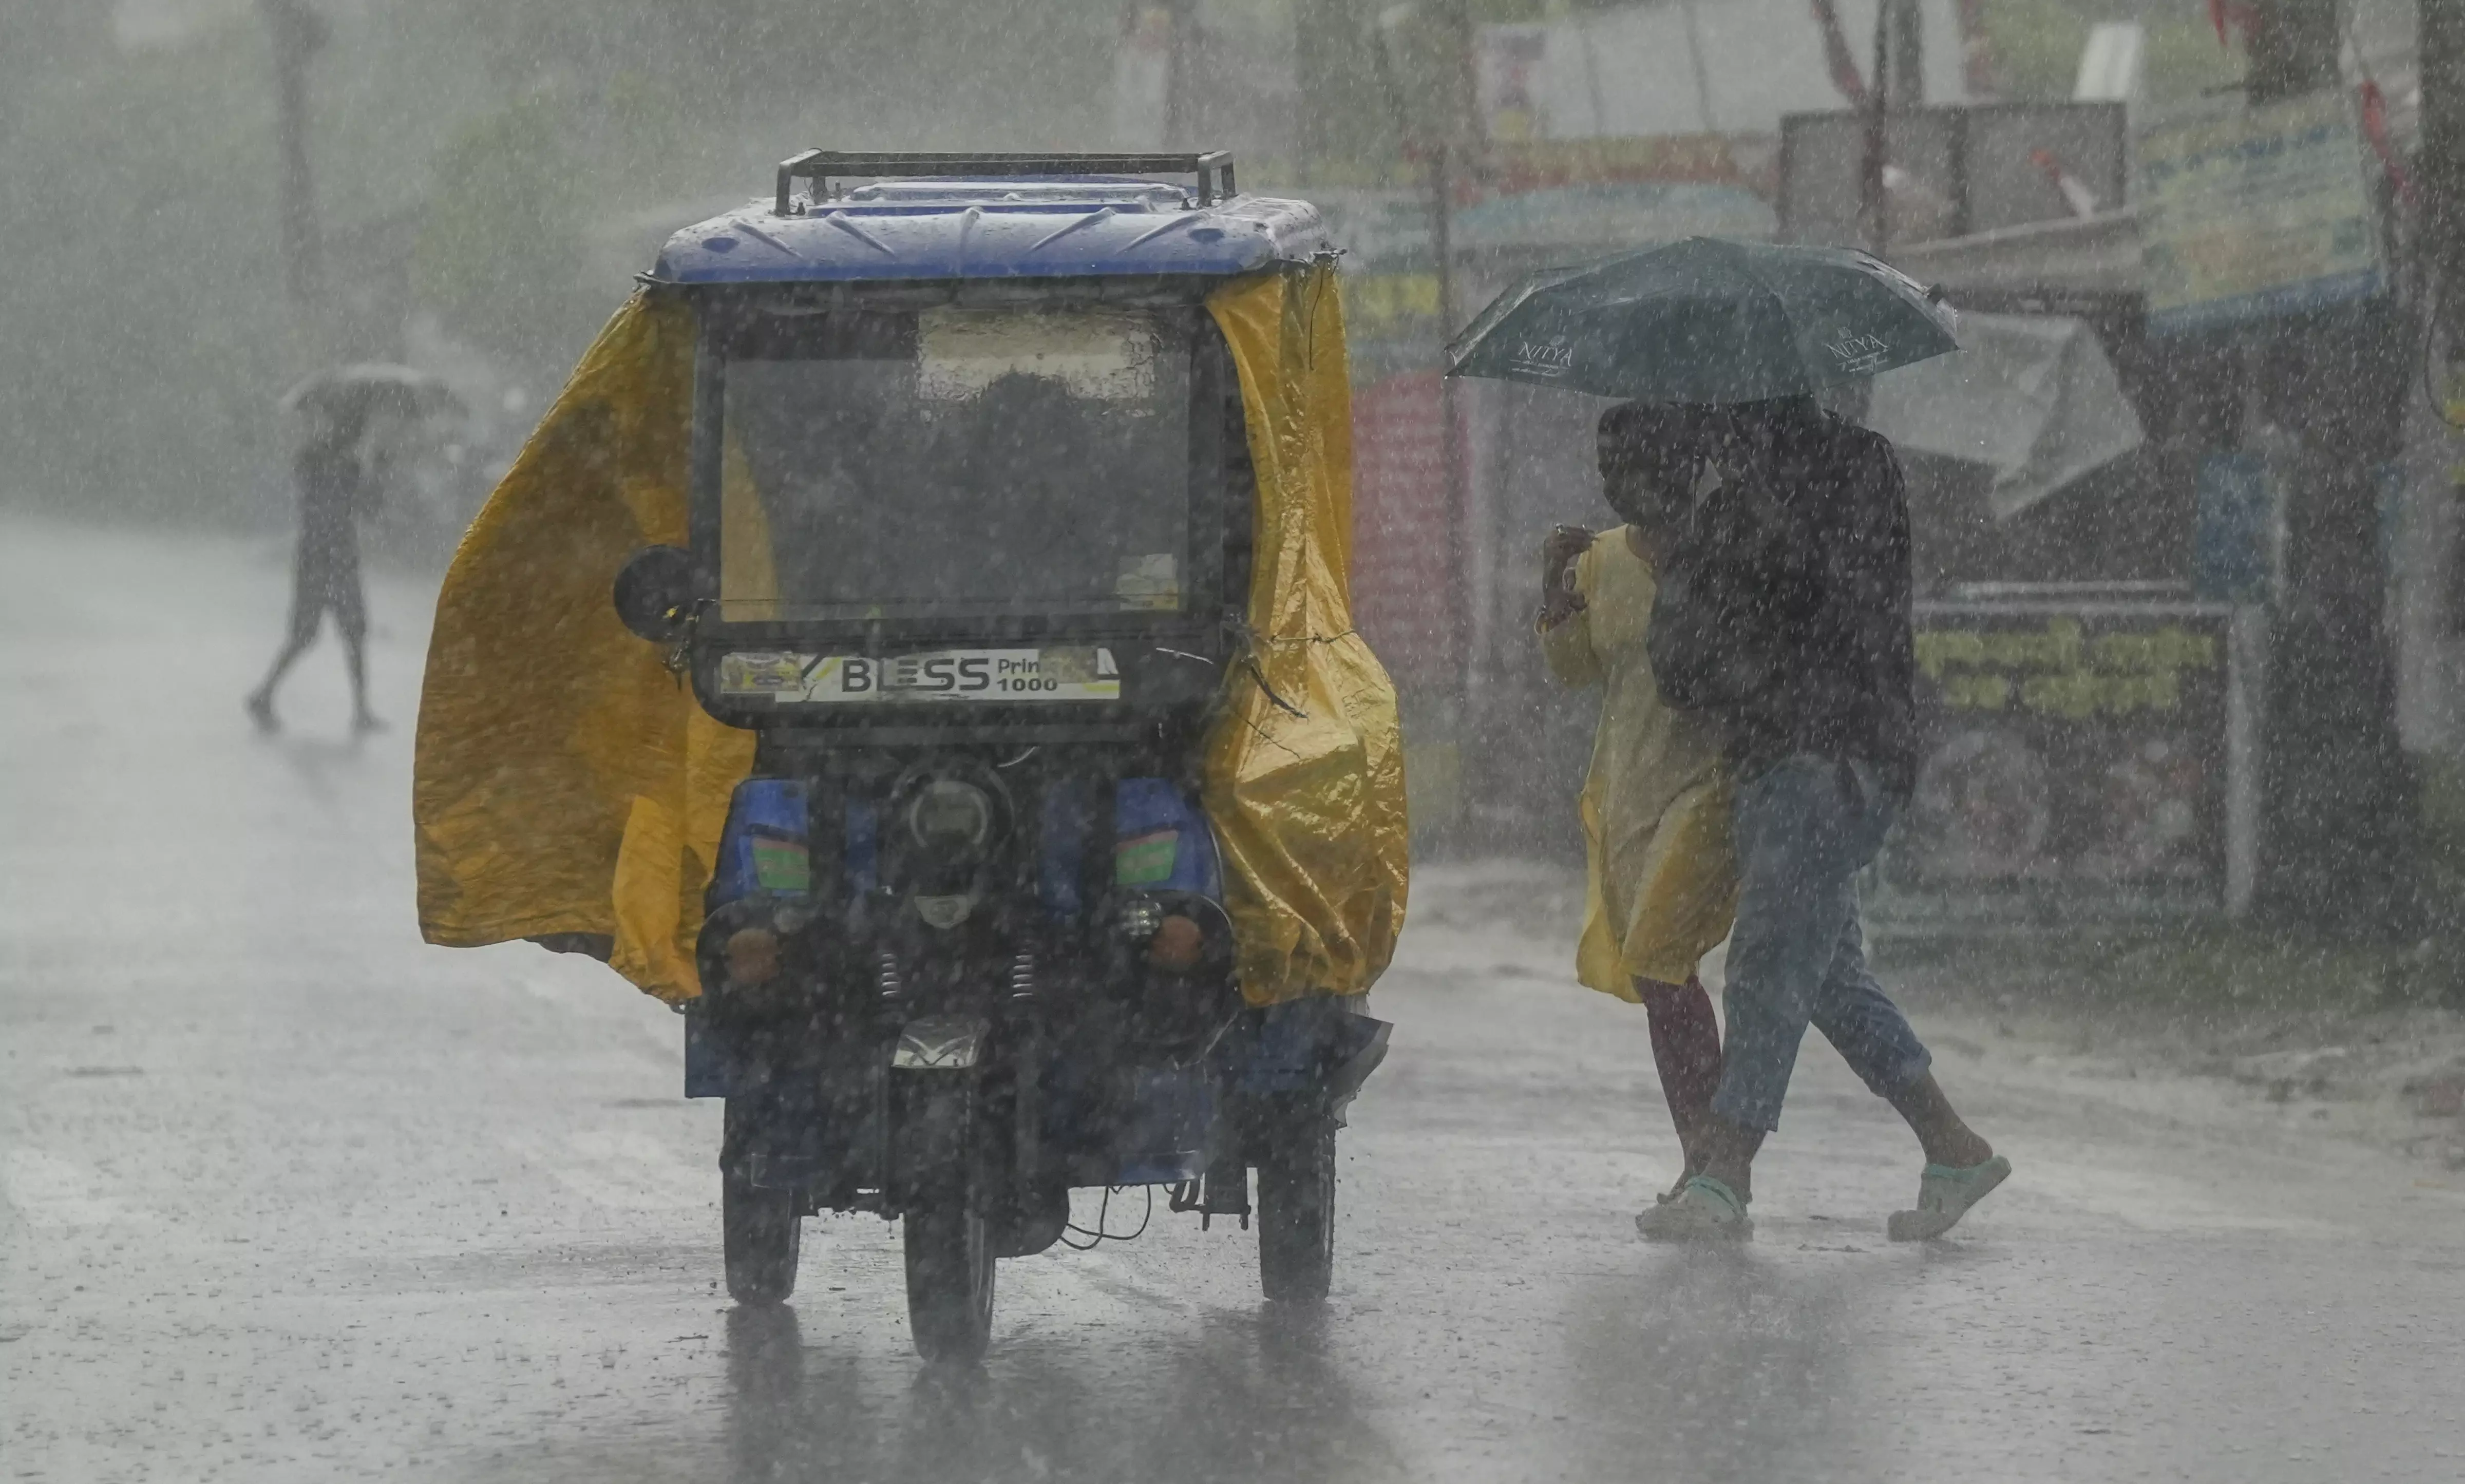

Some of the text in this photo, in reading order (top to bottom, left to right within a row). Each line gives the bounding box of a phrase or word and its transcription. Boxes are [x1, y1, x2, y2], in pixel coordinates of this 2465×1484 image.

[1519, 341, 1572, 367] NITYA
[1825, 334, 1888, 358] NITYA
[842, 658, 990, 692] BLESS
[997, 678, 1058, 692] 1000
